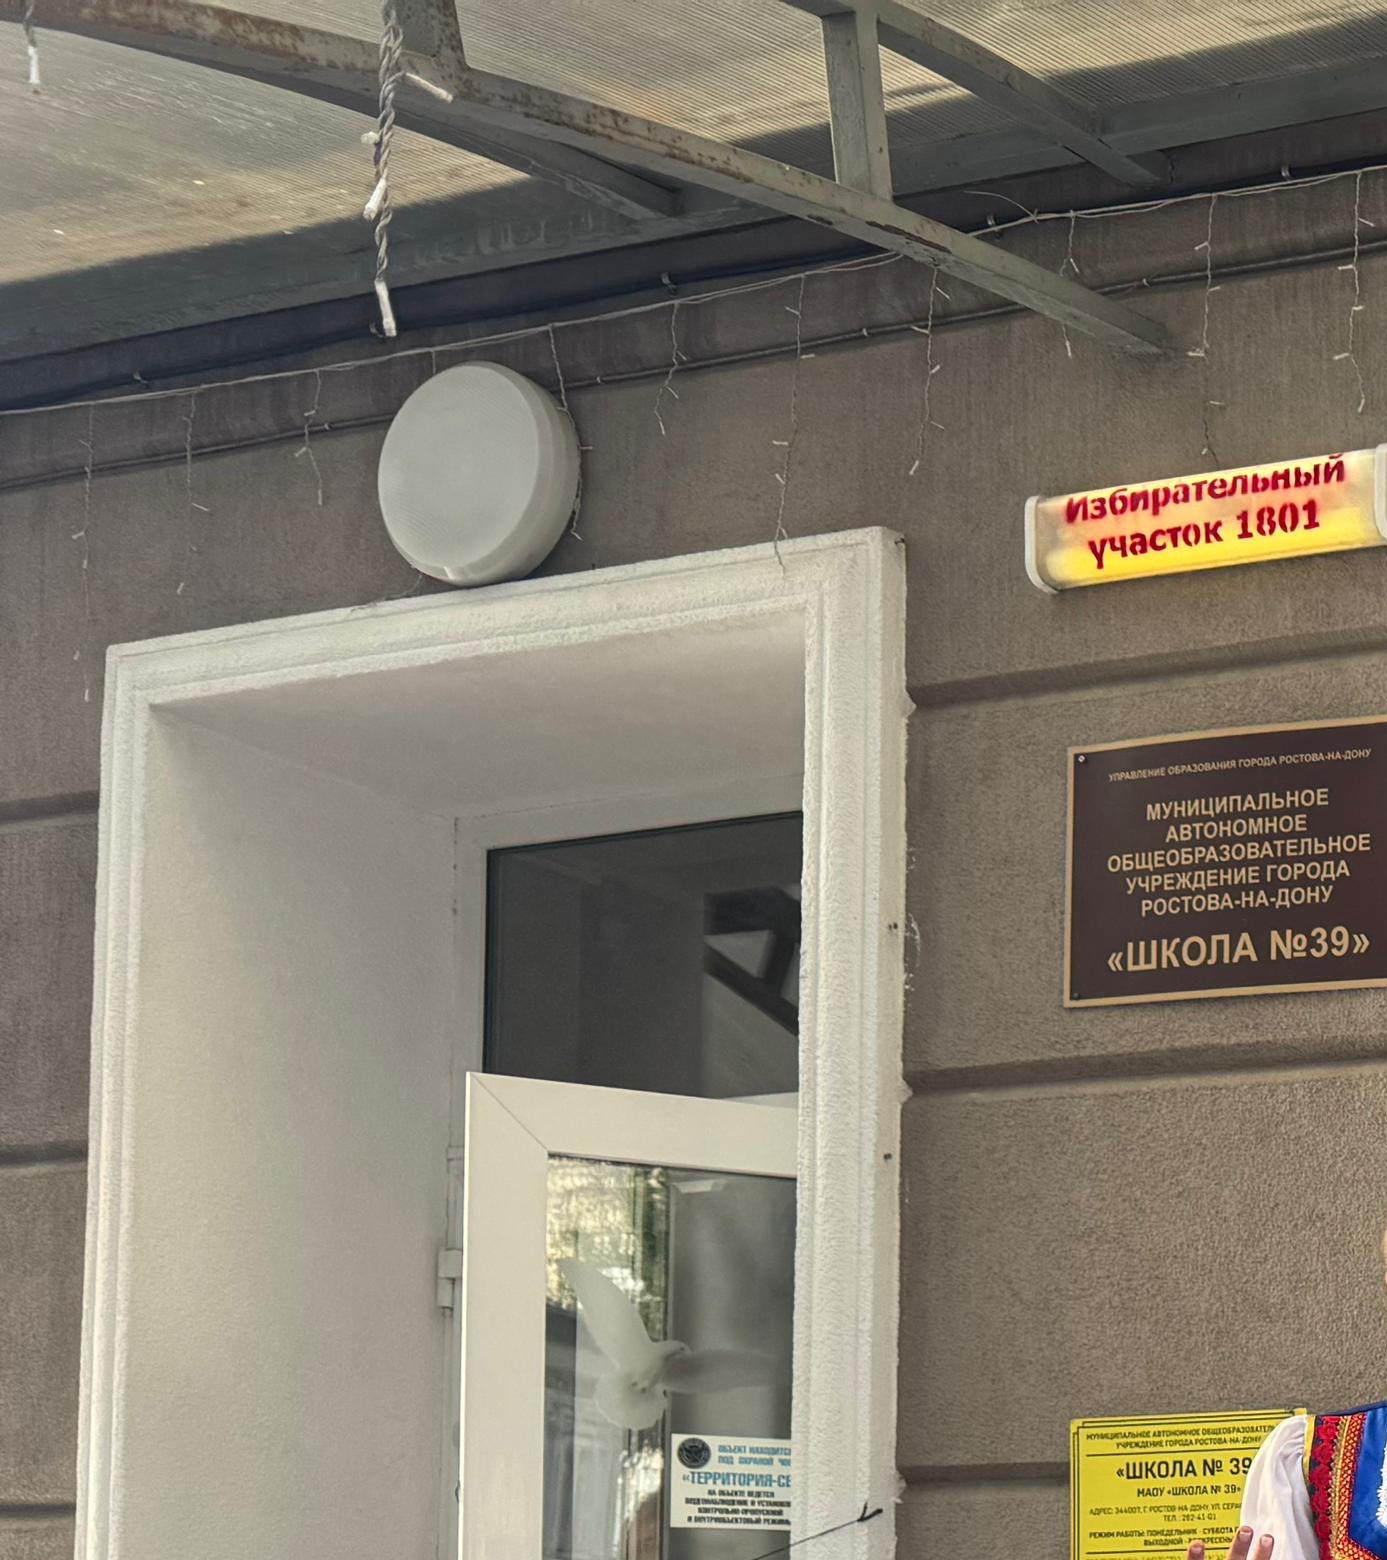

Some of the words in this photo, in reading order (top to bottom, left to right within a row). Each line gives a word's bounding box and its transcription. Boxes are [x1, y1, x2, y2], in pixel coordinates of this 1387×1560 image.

[1065, 452, 1345, 524] Избирательный
[1088, 519, 1223, 570] участок
[1237, 499, 1320, 540] 1801
[1108, 767, 1166, 782] УПРАВЛЕНИЕ
[1167, 760, 1237, 776] ОБРАЗОВАНИЯ
[1238, 756, 1277, 768] ГОРОДА
[1279, 748, 1371, 764] РОСТОВА-НА-ДОНУ
[1146, 788, 1329, 821] МУНИЦИПАЛЬНОЕ
[1165, 814, 1308, 843] АВТОНОМНОЕ
[1107, 833, 1371, 872] ОБЩЕОБРАЗОВАТЕЛЬНОЕ
[1126, 867, 1260, 894] УЧРЕЖДЕНИЕ
[1266, 860, 1350, 883] ГОРОДА
[1141, 885, 1333, 917] РОСТОВА-НА-ДОНУ
[1107, 932, 1258, 972] «ШКОЛА
[1270, 925, 1370, 961] №39»
[1086, 1431, 1151, 1440] МУНИЦИПАЛЬНОЕ
[1152, 1428, 1200, 1438] АВТОНОМНОЕ
[1116, 1441, 1164, 1450] УЧРЕЖДЕНИЕ
[1165, 1439, 1193, 1447] ГОРОДА
[1116, 1459, 1198, 1480] «ШКОЛА
[1202, 1458, 1223, 1477] №
[1136, 1486, 1165, 1498] МАОУ
[1167, 1485, 1209, 1497] «ШКОЛА
[1210, 1484, 1221, 1495] №
